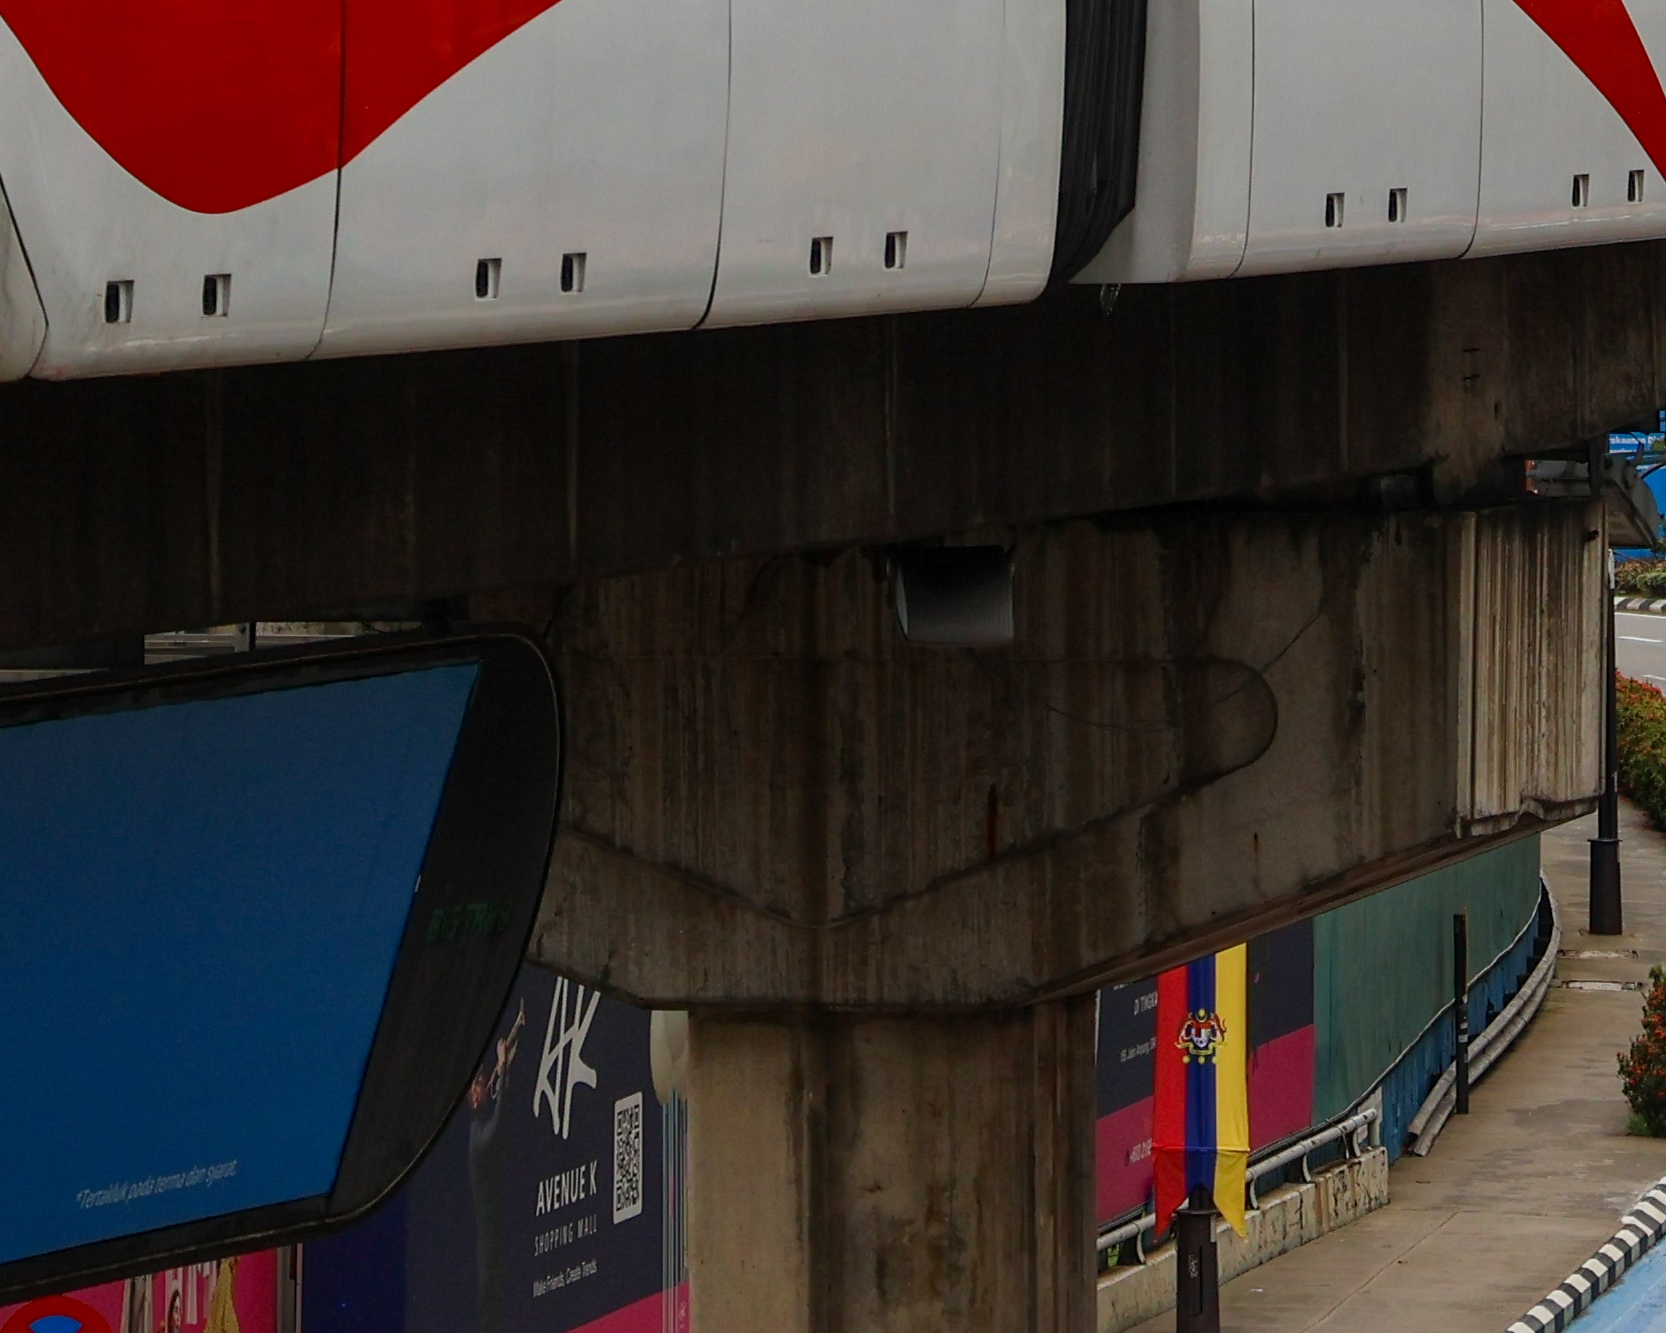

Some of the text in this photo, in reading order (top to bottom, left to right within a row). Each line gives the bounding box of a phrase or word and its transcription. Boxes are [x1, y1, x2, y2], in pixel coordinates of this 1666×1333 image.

[535, 1159, 598, 1217] AVENUE K
[533, 1213, 598, 1257] SHOPPING MALL
